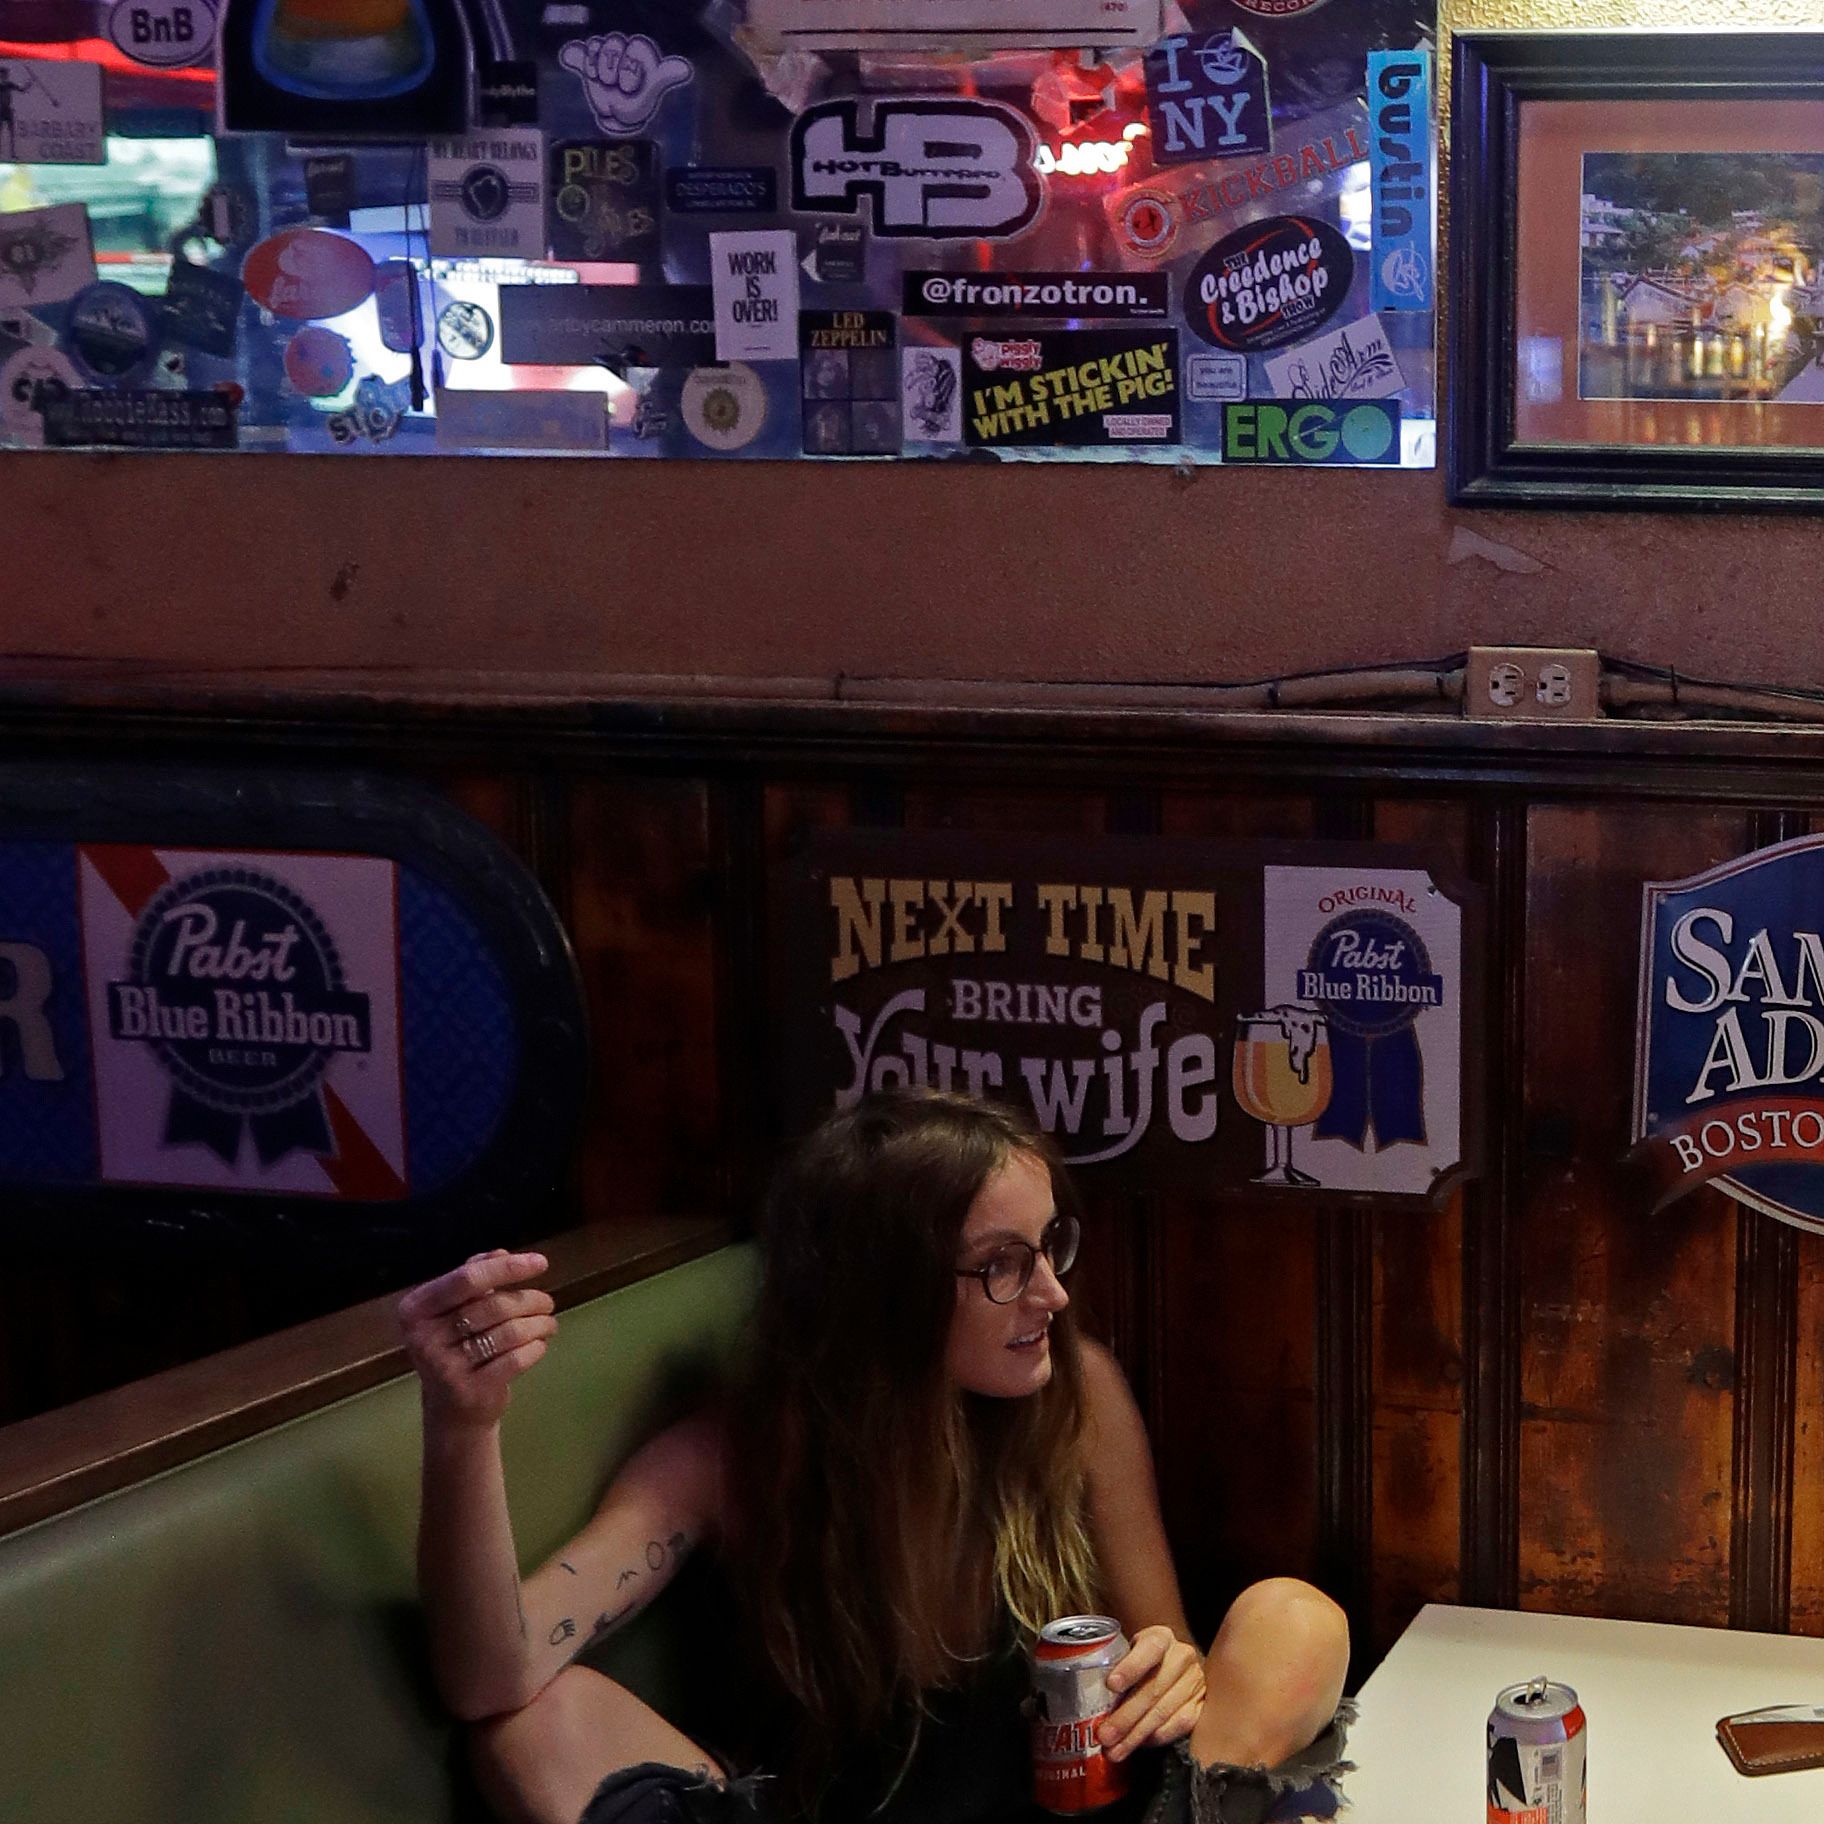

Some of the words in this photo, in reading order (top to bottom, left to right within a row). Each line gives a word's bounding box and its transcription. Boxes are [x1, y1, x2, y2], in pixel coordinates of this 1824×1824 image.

[131, 7, 194, 43] BnB
[1157, 38, 1194, 93] I
[1158, 91, 1251, 152] NY
[1378, 63, 1426, 238] bustin
[1180, 128, 1370, 225] KICKBALL
[728, 251, 776, 275] WORK
[1199, 237, 1323, 304] Creedence
[1223, 250, 1249, 270] THE
[746, 276, 762, 298] IS
[1220, 301, 1236, 325] &
[1235, 266, 1329, 324] Bishop
[1279, 294, 1315, 320] SHOW
[732, 298, 778, 323] OVER!
[832, 312, 865, 328] LED
[811, 329, 888, 347] ZEPPELIN
[1000, 339, 1042, 355] piggly
[972, 379, 1024, 416] I'M
[1029, 341, 1170, 402] STICKIN'
[1000, 355, 1043, 370] wiggly
[972, 403, 1051, 441] WITH
[1053, 385, 1114, 420] THE
[1117, 369, 1176, 405] PIG!
[1316, 884, 1418, 915] ORIGINAL
[163, 903, 300, 982] Pabst
[829, 877, 1014, 982] NEXT
[1037, 882, 1218, 1003] TIME
[1328, 929, 1406, 970] Pabst
[950, 979, 1104, 1029] BRING
[1301, 972, 1352, 1002] Blue
[1354, 973, 1438, 1005] Ribbon
[117, 987, 209, 1040] Blue
[215, 990, 363, 1048] Ribbon
[208, 1047, 278, 1067] BEER
[833, 987, 1004, 1114] Your
[1019, 1001, 1219, 1164] wife
